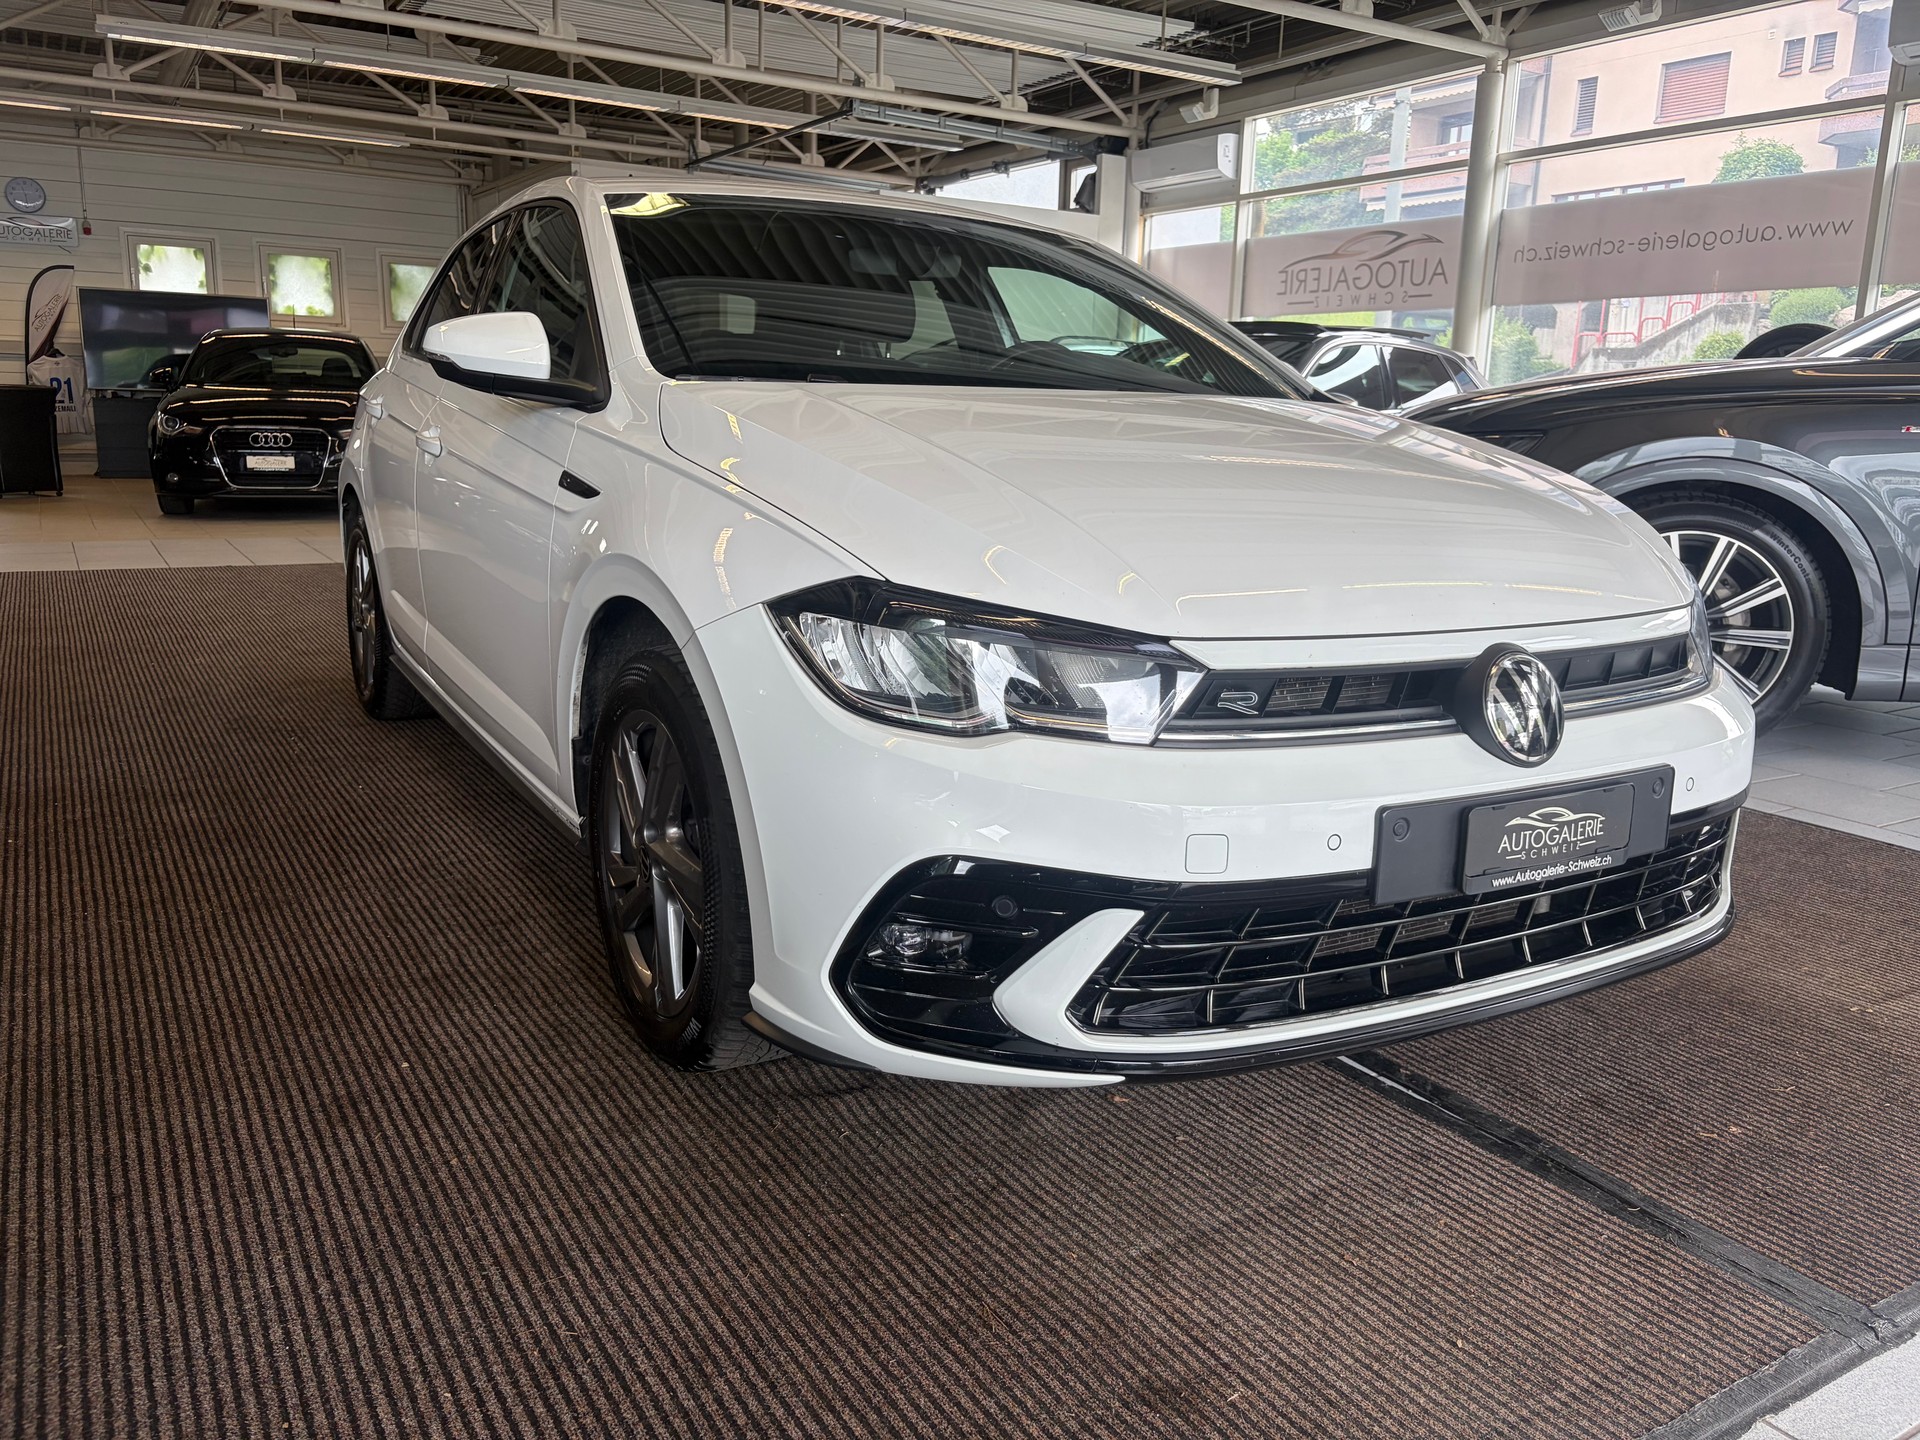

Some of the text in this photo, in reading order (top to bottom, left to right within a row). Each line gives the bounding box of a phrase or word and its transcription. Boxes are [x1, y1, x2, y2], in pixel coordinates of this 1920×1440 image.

[0, 225, 73, 240] UTOGALERIE
[1498, 817, 1605, 854] AUTOGALERIE
[1520, 841, 1581, 860] SCHWEIZ
[1491, 854, 1612, 887] www.Autogalerie-Schweiz.ch
